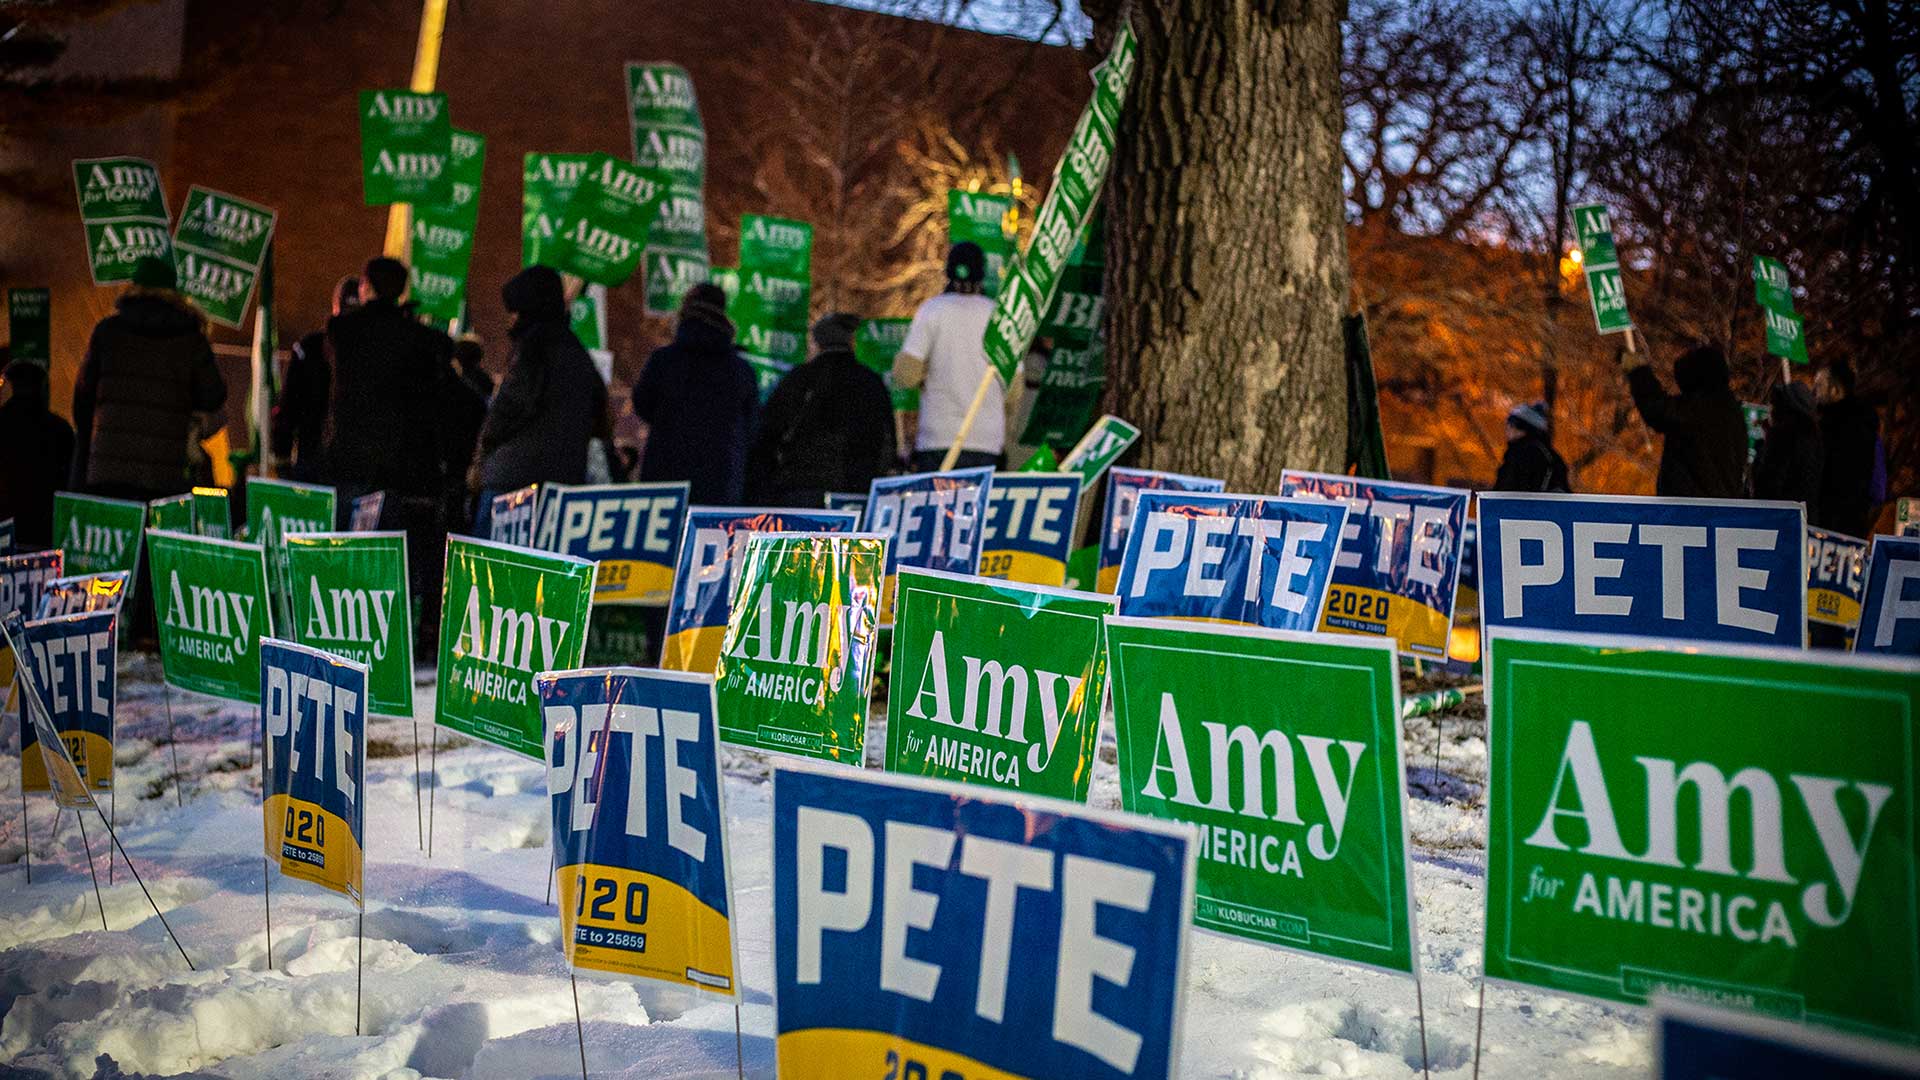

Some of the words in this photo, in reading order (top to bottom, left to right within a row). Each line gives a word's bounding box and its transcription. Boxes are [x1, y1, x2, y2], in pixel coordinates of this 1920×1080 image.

[367, 92, 444, 124] Amy
[372, 149, 447, 181] Amy
[62, 515, 132, 565] Amy
[557, 497, 679, 555] PETE
[872, 486, 982, 560] PETE
[982, 487, 1072, 545] ETE
[1334, 499, 1452, 588] ETE
[1130, 512, 1328, 614] PETE
[1499, 518, 1779, 635] PETE
[1808, 537, 1864, 592] PETE
[164, 569, 254, 656] Amy
[305, 575, 396, 661] Amy
[451, 584, 571, 697] Amy
[729, 582, 853, 693] Amy
[1328, 589, 1389, 620] 2020
[178, 634, 234, 666] AMERICA
[319, 647, 373, 673] ERICA
[464, 667, 527, 706] AMERICA
[723, 669, 744, 692] for
[744, 671, 825, 706] AMERICA
[266, 665, 357, 806] PETE
[905, 630, 1084, 773] Amy
[544, 704, 708, 863] PETE
[903, 729, 924, 756] for
[924, 735, 1020, 787] AMERICA
[1141, 691, 1367, 862] Amy
[1523, 720, 1894, 928] Amy
[590, 931, 604, 943] to
[606, 934, 645, 949] 25859
[797, 806, 1156, 1076] PETE
[1523, 866, 1565, 904] for
[1572, 873, 1798, 948] AMERICA
